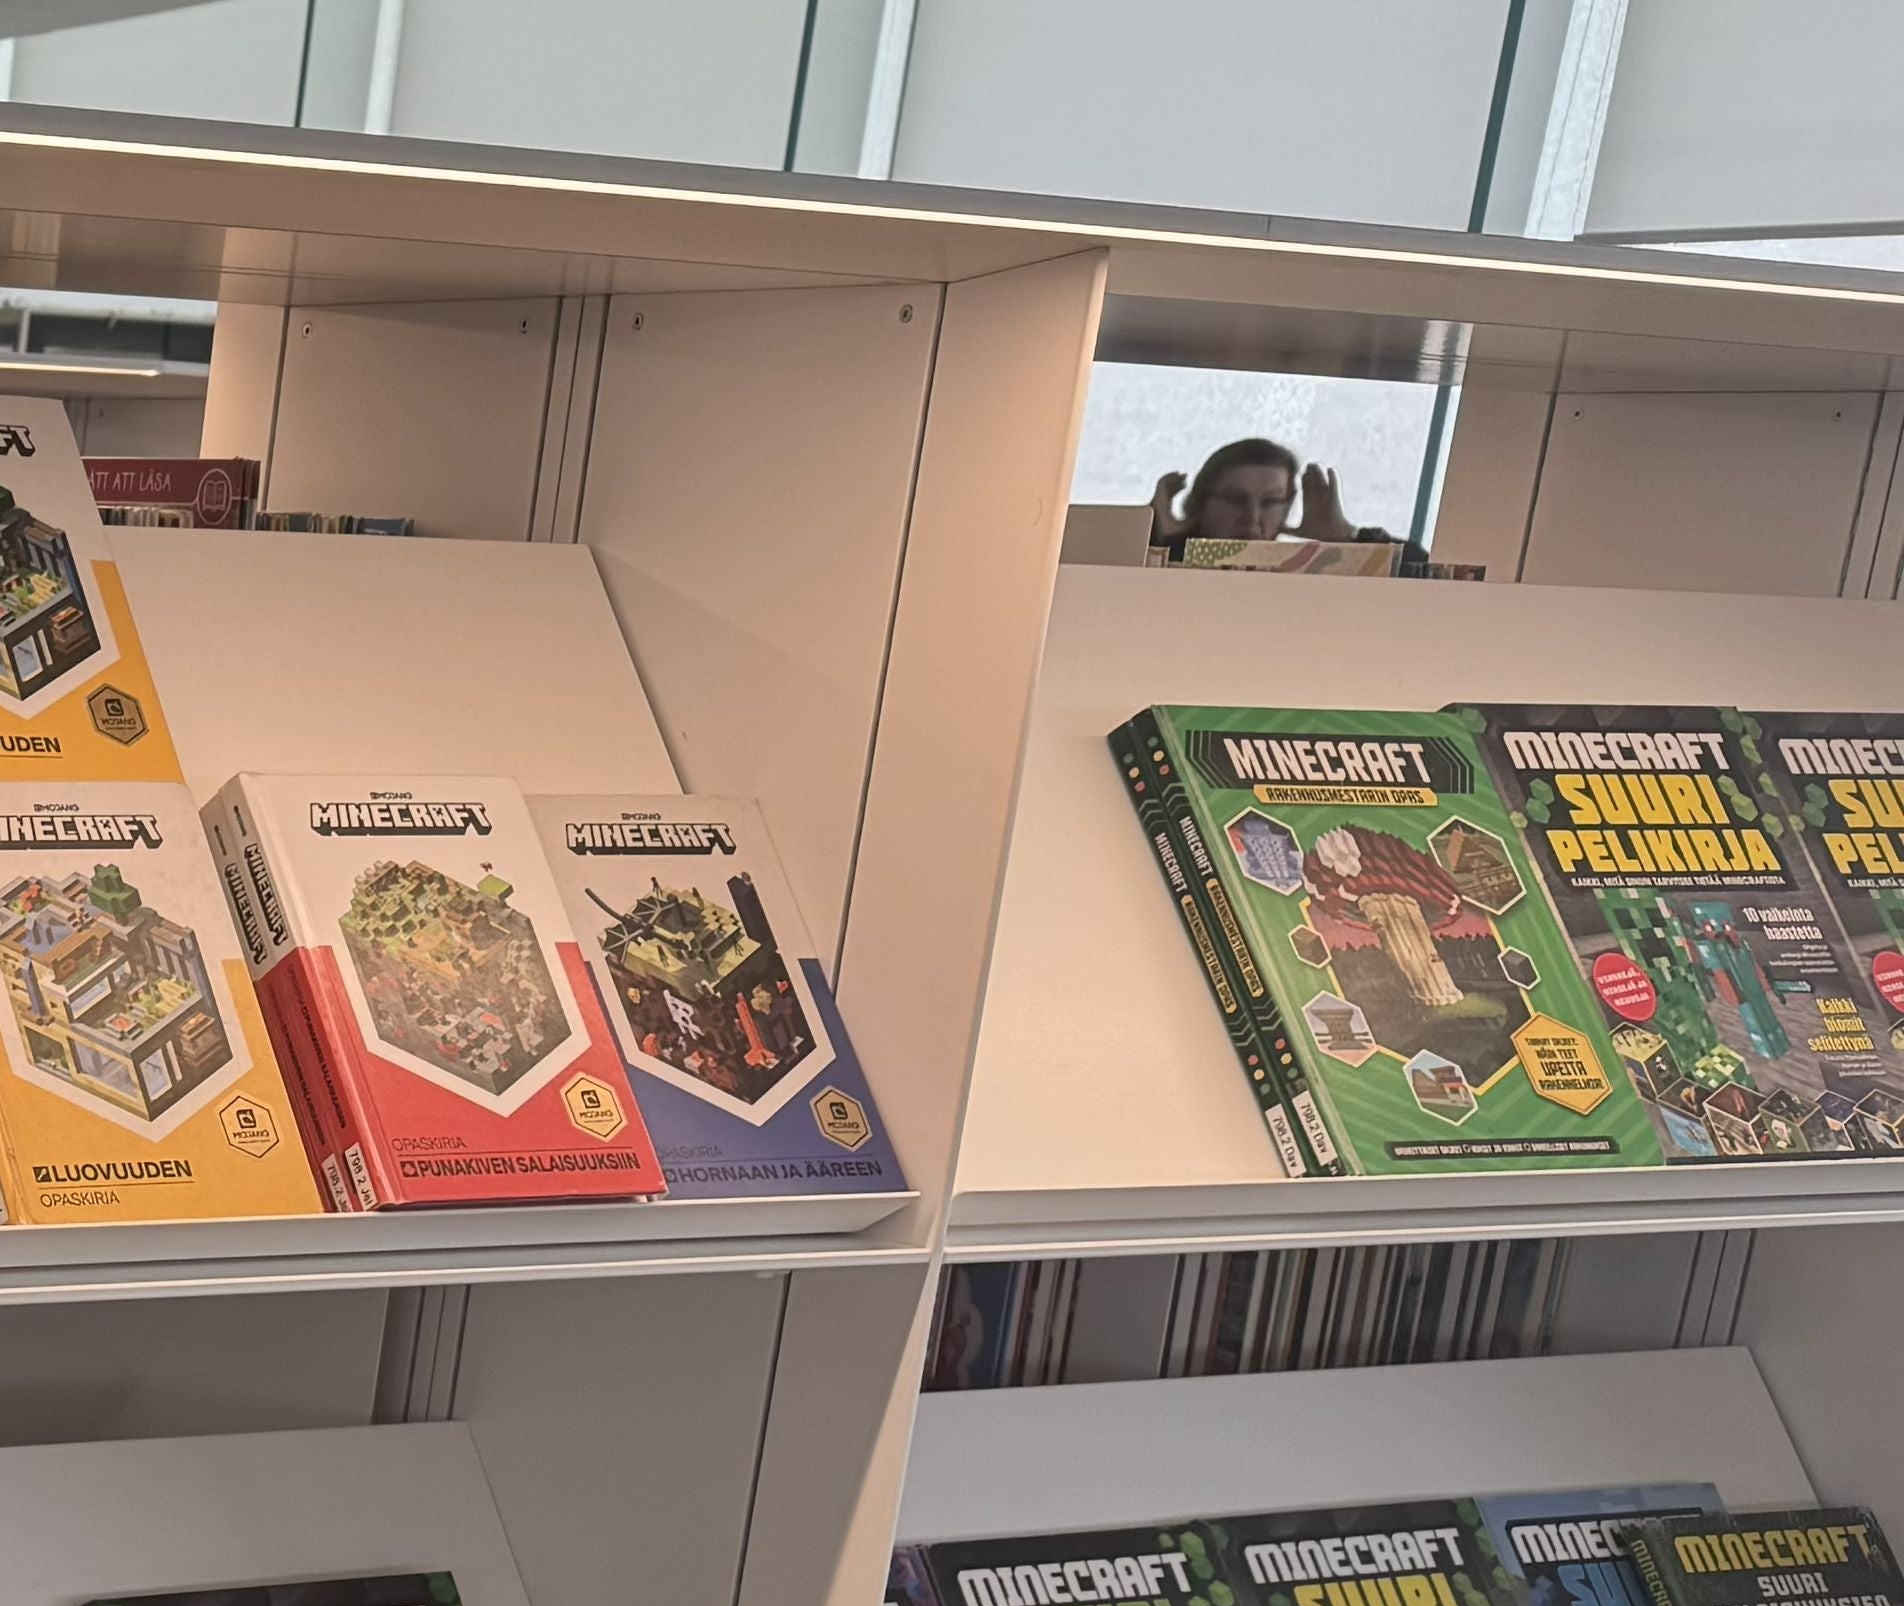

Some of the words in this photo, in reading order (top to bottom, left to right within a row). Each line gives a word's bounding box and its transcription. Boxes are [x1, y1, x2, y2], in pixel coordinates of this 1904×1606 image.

[112, 472, 134, 490] ATT
[139, 471, 171, 491] LÄSA
[1222, 736, 1432, 786] MINECRAFT
[1503, 731, 1729, 771] MINECRAFT
[1390, 789, 1426, 806] OPAS
[1554, 773, 1730, 826] SUURI
[309, 802, 493, 837] MINECRAFT
[565, 823, 736, 856] MINECRAFT
[1546, 829, 1783, 874] PELIKIRJA
[244, 843, 288, 946] MINECRAFT
[49, 1159, 193, 1183] LUOVUUDEN
[418, 1157, 516, 1177] PUNAKIVEN
[517, 1152, 641, 1173] SALAISUUKSIIN
[679, 1165, 782, 1183] HORNAAN
[805, 1160, 882, 1178] ÄÄREEN
[40, 1190, 120, 1208] OPASKIRJA
[1244, 1527, 1465, 1584] MINECRAFT
[1674, 1524, 1873, 1575] MINECRAFT
[1757, 1572, 1830, 1598] SUURI
